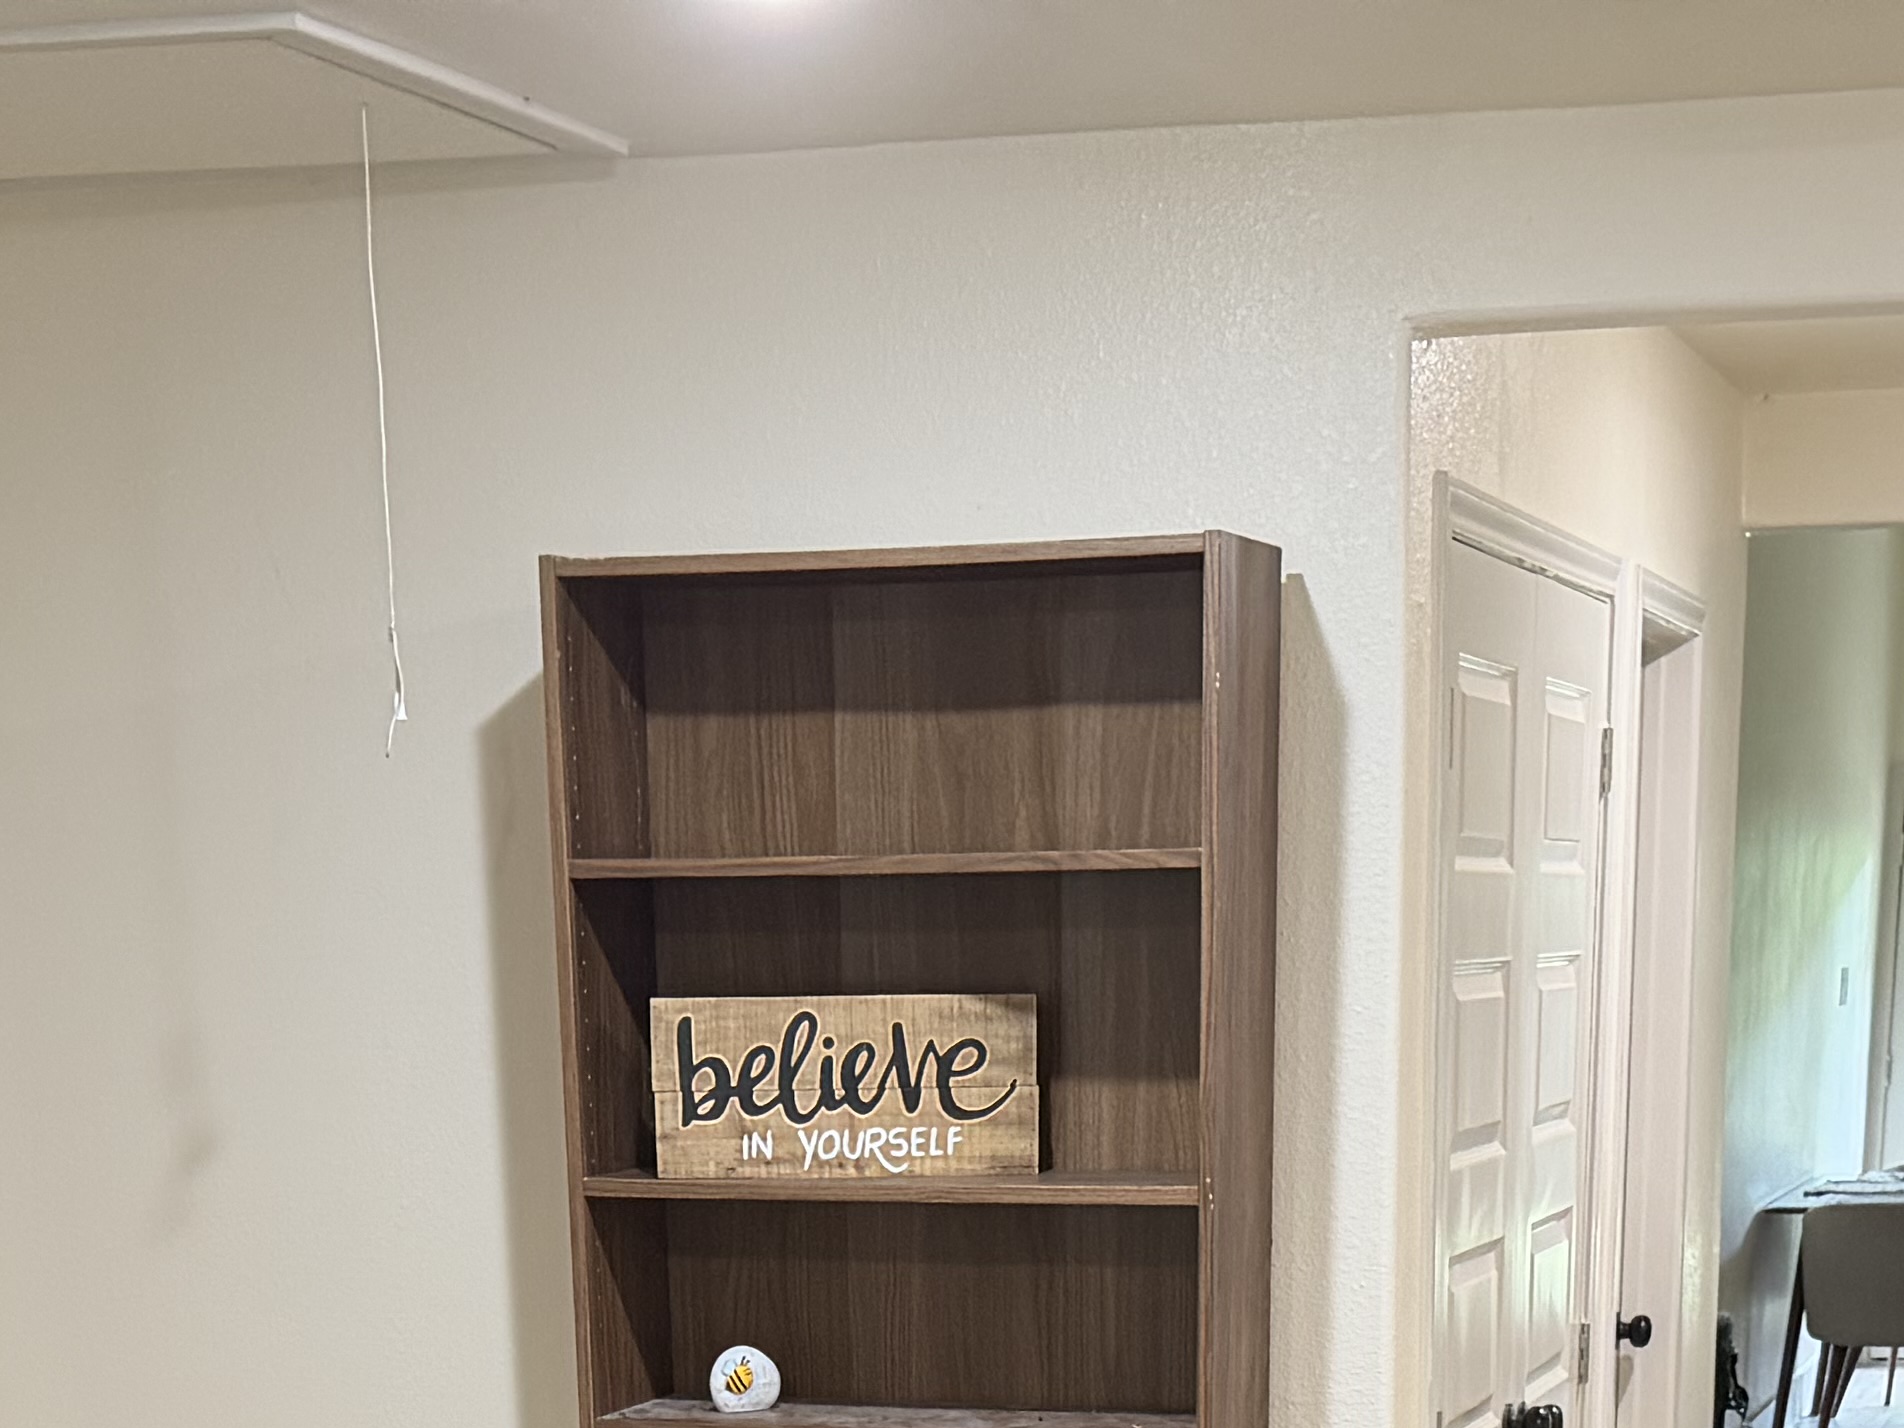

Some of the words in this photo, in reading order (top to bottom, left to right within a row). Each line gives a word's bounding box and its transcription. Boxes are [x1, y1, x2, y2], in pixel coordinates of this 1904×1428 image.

[676, 1010, 1018, 1128] believe
[741, 1129, 774, 1161] IN
[797, 1126, 964, 1173] YOURSELF
